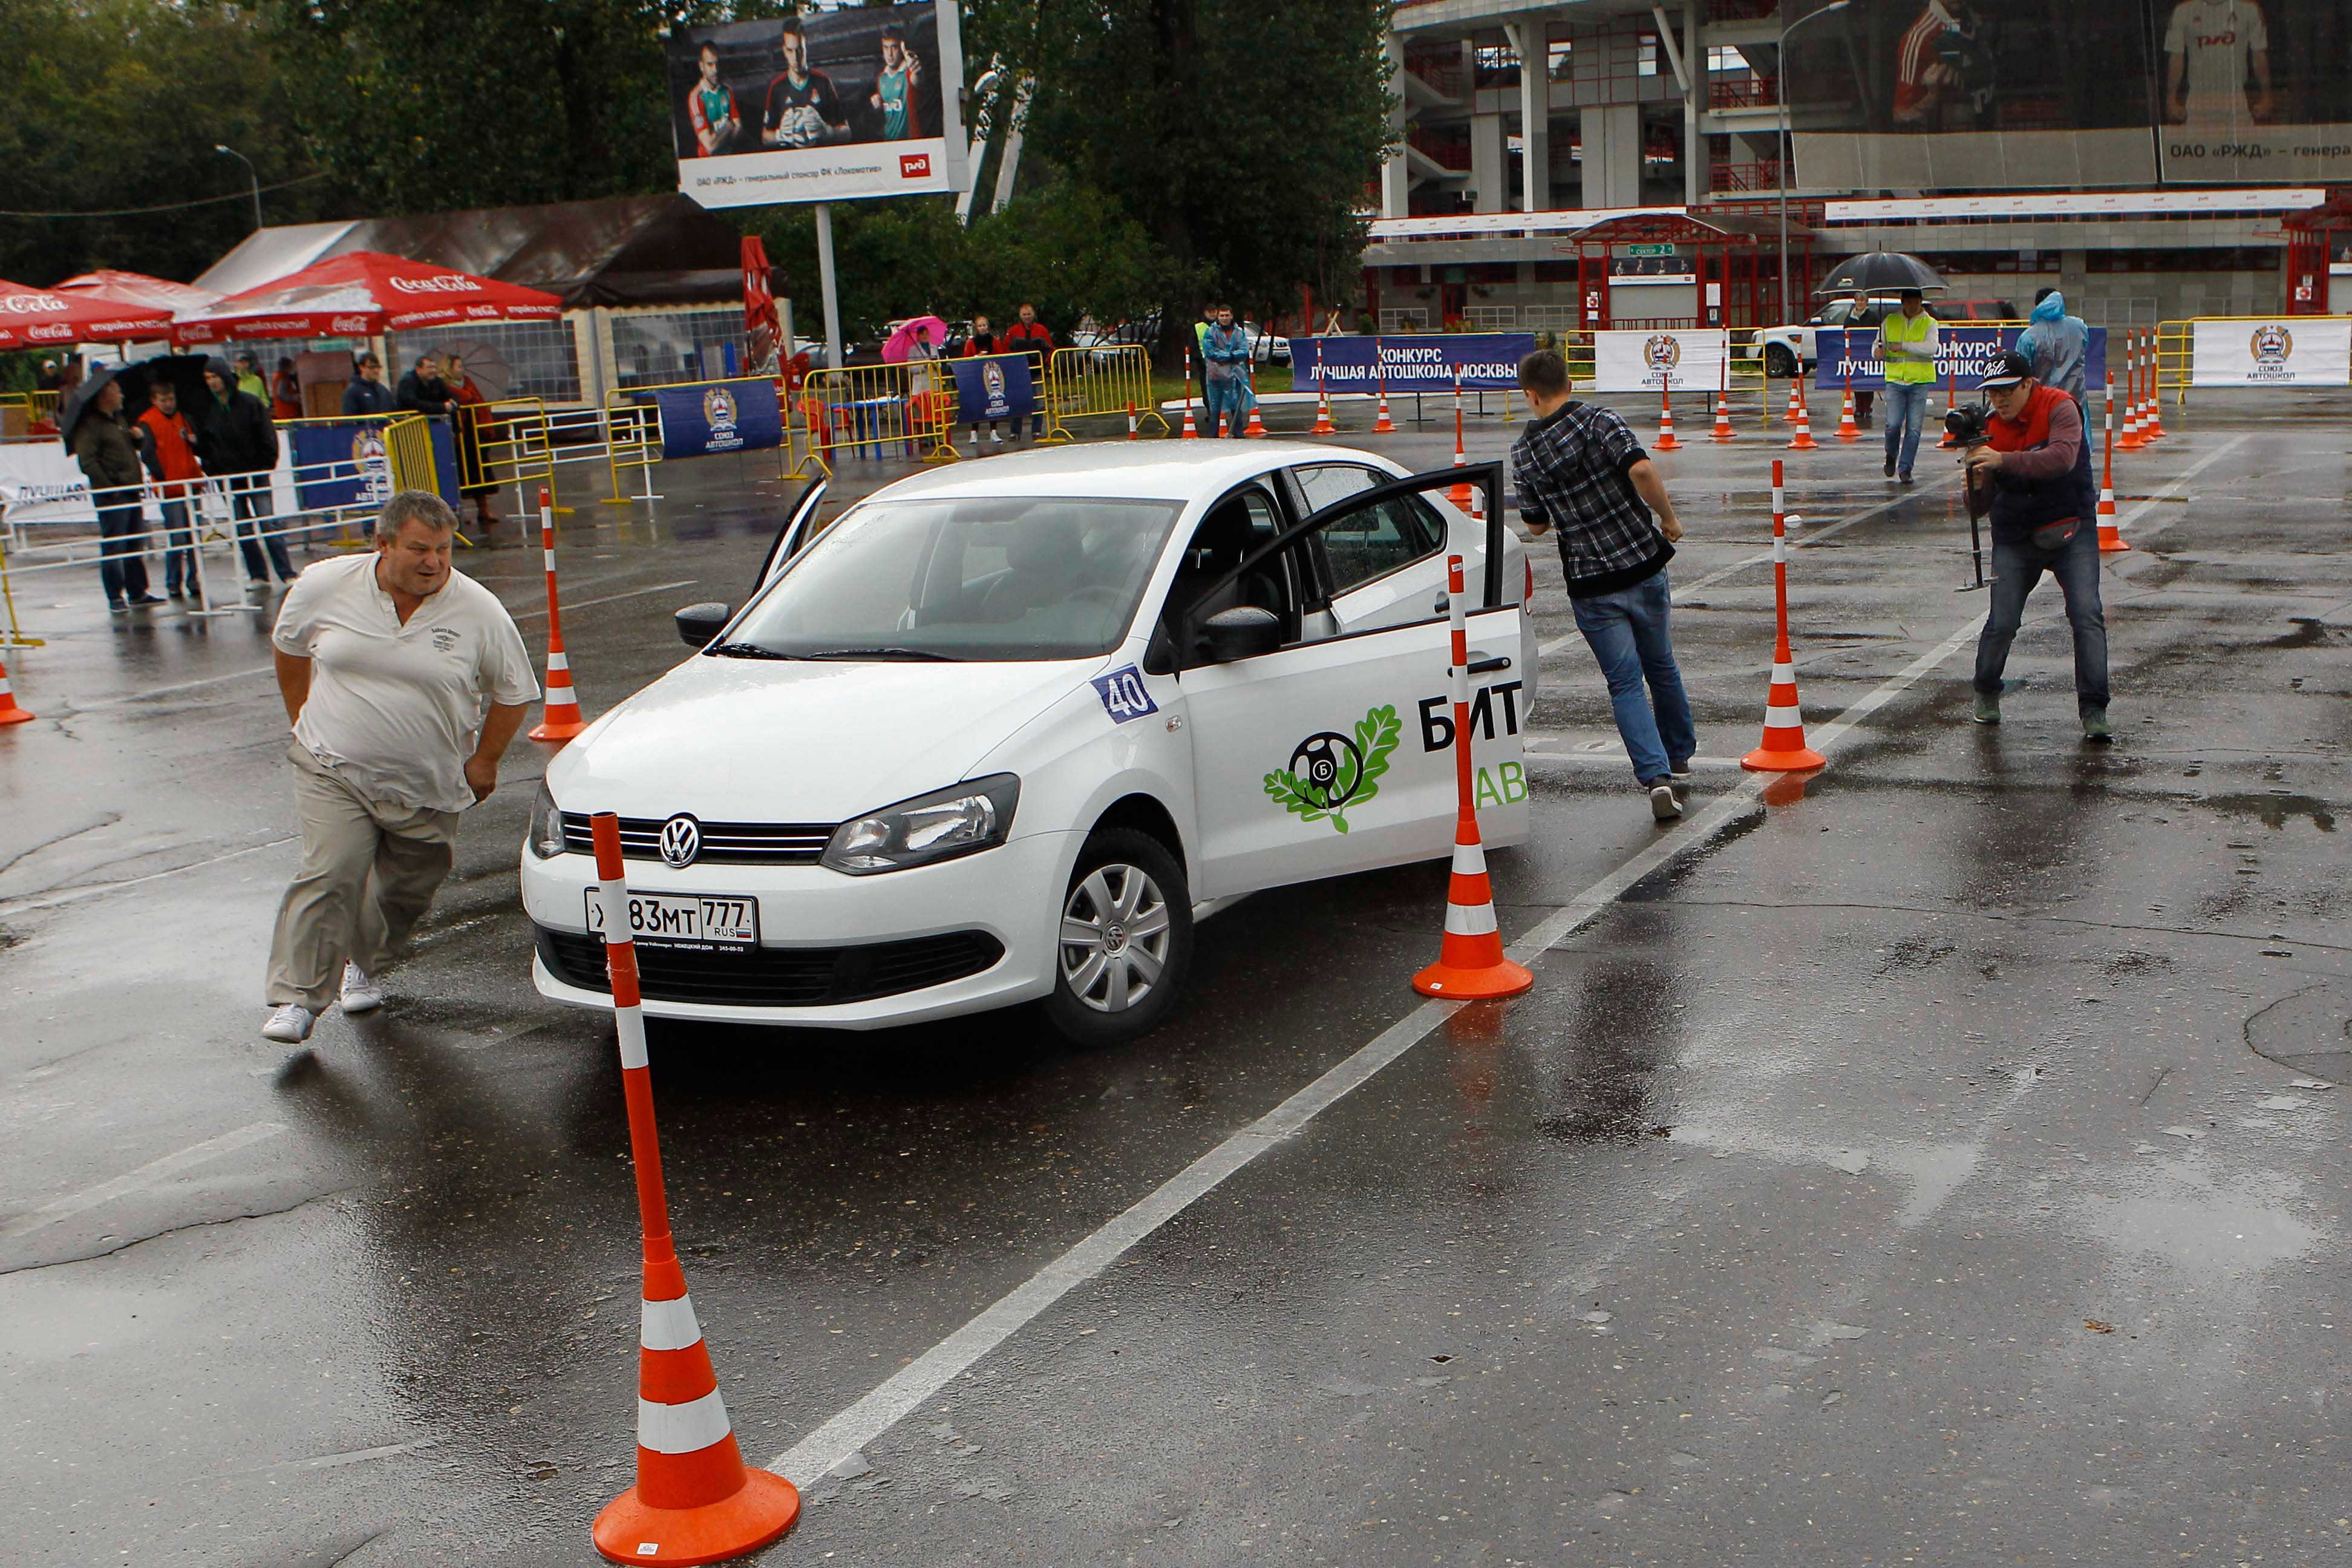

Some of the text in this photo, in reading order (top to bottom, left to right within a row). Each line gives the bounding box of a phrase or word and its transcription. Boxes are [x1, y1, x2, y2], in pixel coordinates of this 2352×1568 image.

[2170, 144, 2206, 158] ОАО
[2212, 144, 2270, 159] «РЖД»
[1659, 244, 1665, 254] 2
[1933, 342, 1996, 358] ОНКУРС
[1836, 361, 1884, 376] ЛУЧШ
[1108, 673, 1149, 717] 40
[1319, 763, 1328, 776] Б
[714, 927, 736, 937] RUS
